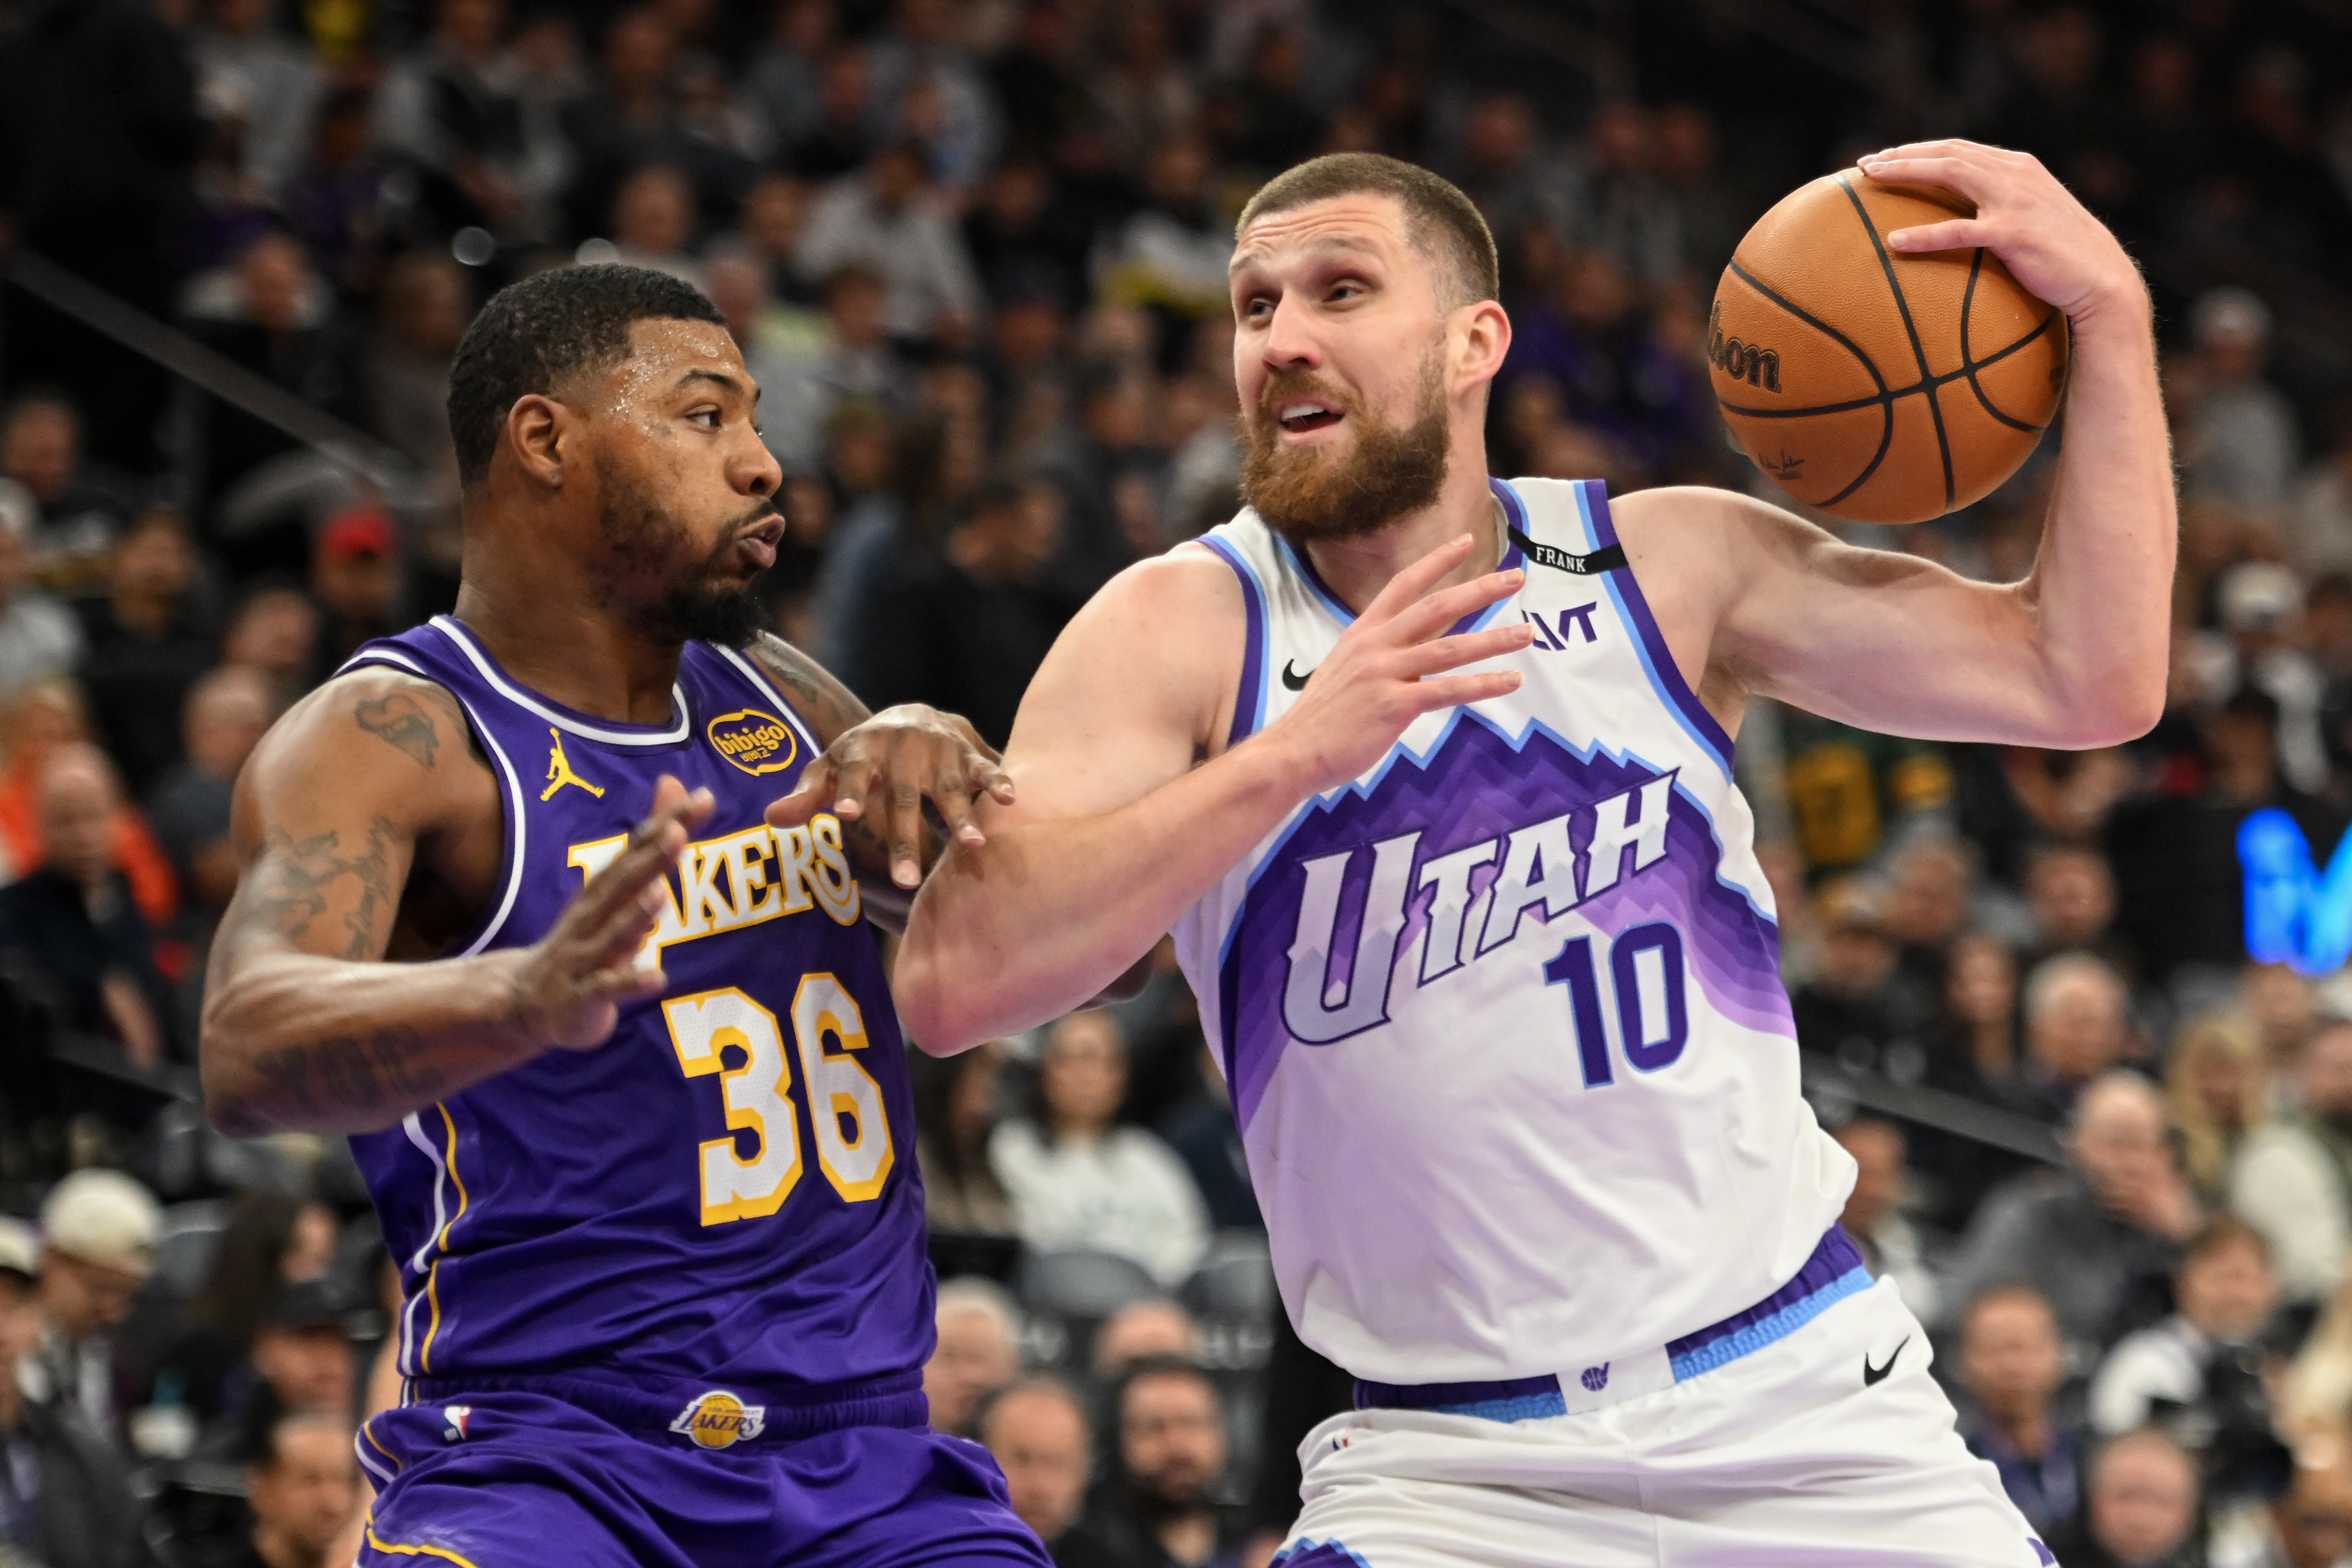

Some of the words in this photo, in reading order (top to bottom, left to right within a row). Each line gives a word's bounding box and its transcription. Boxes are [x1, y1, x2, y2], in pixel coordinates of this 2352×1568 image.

[1708, 300, 1782, 394] lson
[1536, 546, 1587, 573] FRANK
[714, 725, 786, 754] bibigo
[1279, 766, 1681, 1046] UTAH
[1543, 920, 1688, 1089] 10
[660, 972, 895, 1227] 36
